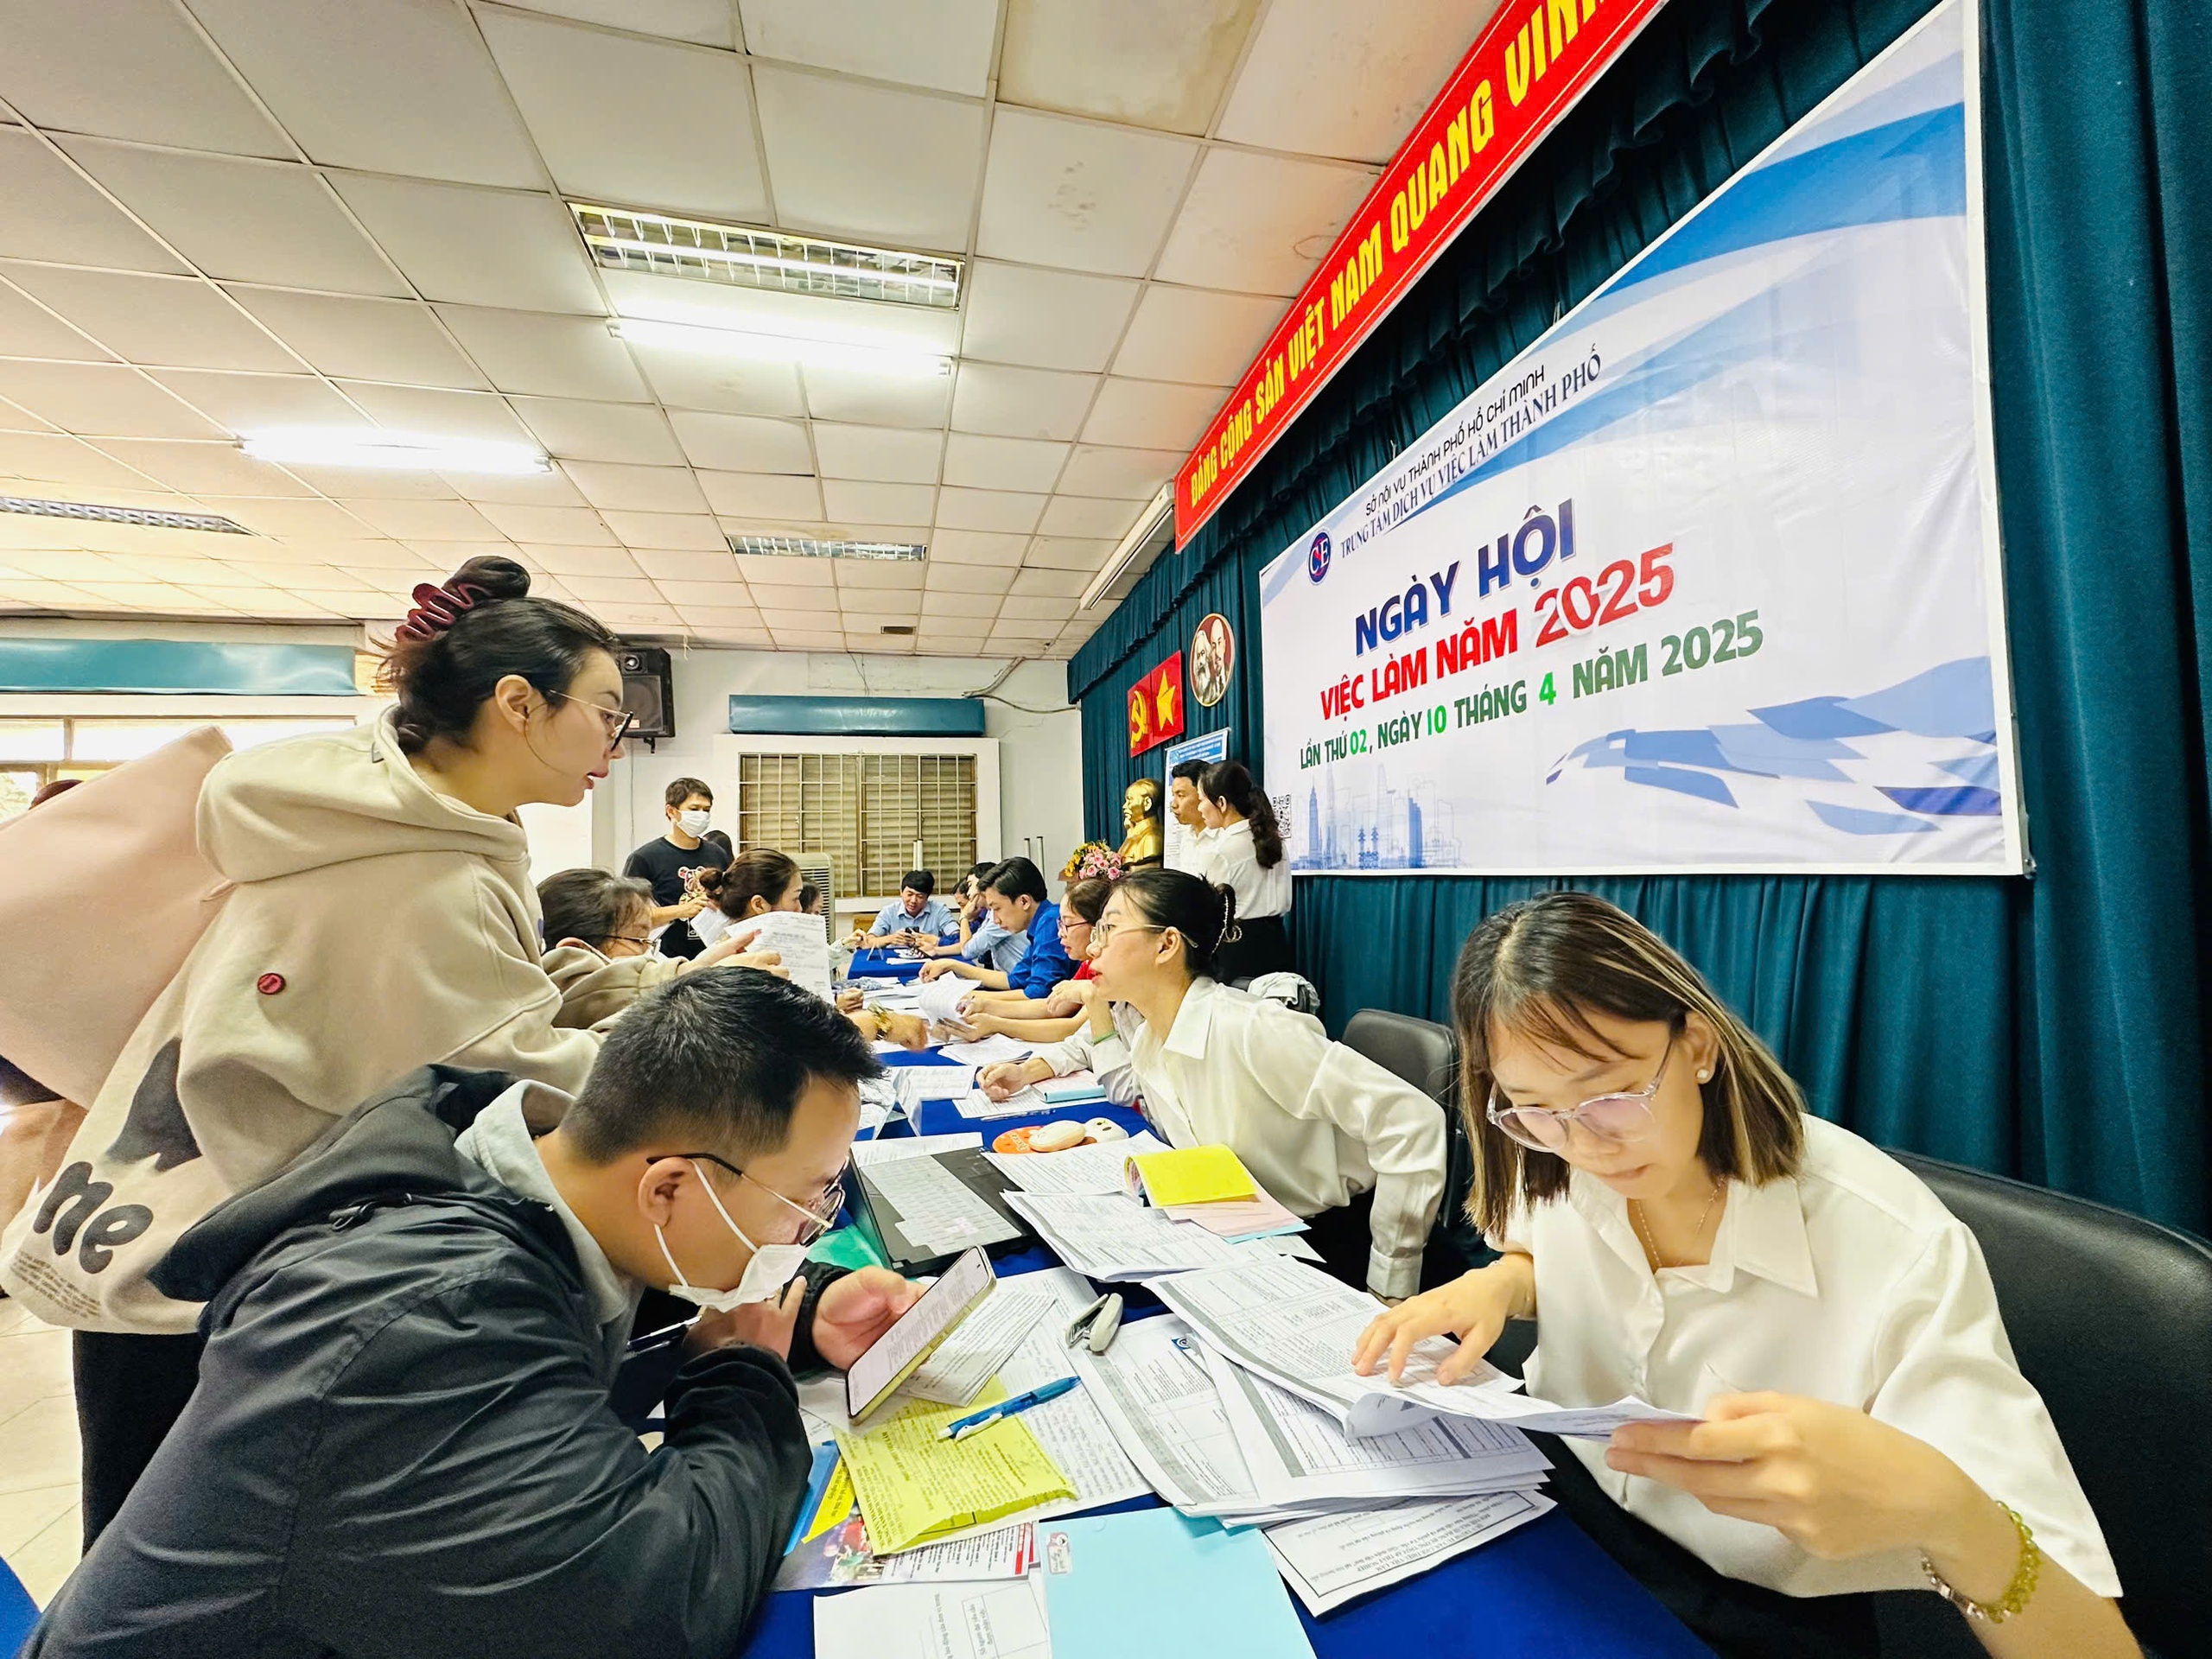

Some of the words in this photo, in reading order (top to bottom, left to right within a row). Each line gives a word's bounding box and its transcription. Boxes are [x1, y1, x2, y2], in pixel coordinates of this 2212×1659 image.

[1192, 443, 1217, 508] ĐẢNG
[1220, 398, 1253, 468] CỘNG
[1255, 358, 1285, 424] SẢN
[1287, 296, 1325, 369] VIỆT
[1331, 220, 1382, 330] NAM
[1390, 79, 1495, 253] QUANG
[1504, 0, 1597, 107] VIN
[1341, 525, 1370, 559] TRUNG
[1371, 510, 1392, 539] TÂM
[1393, 486, 1419, 521] DỊCH
[1421, 478, 1437, 503] VỤ
[1438, 452, 1466, 487] VIỆC
[1469, 429, 1499, 468] LÀM
[1500, 385, 1557, 445] THÀNH
[1562, 343, 1603, 404] PHỐ
[1394, 476, 1407, 498] VỤ
[1443, 420, 1465, 457] PHỐ
[1486, 393, 1507, 426] CHÍ
[1509, 365, 1545, 407] MINH
[1320, 674, 1364, 722] VIỆC
[1372, 652, 1427, 703] LÀM
[1436, 608, 1518, 679] NĂM
[1534, 542, 1675, 649] 2025
[1355, 560, 1461, 657] NGÀY
[1478, 498, 1577, 597] HỘI
[1300, 736, 1321, 770] LẦN
[1325, 729, 1348, 760] THỨ
[1377, 709, 1421, 748] NGÀY
[1454, 679, 1528, 729] THÁNG
[1538, 671, 1557, 707] 4
[1572, 642, 1649, 700] NĂM
[1660, 609, 1764, 677] 2025
